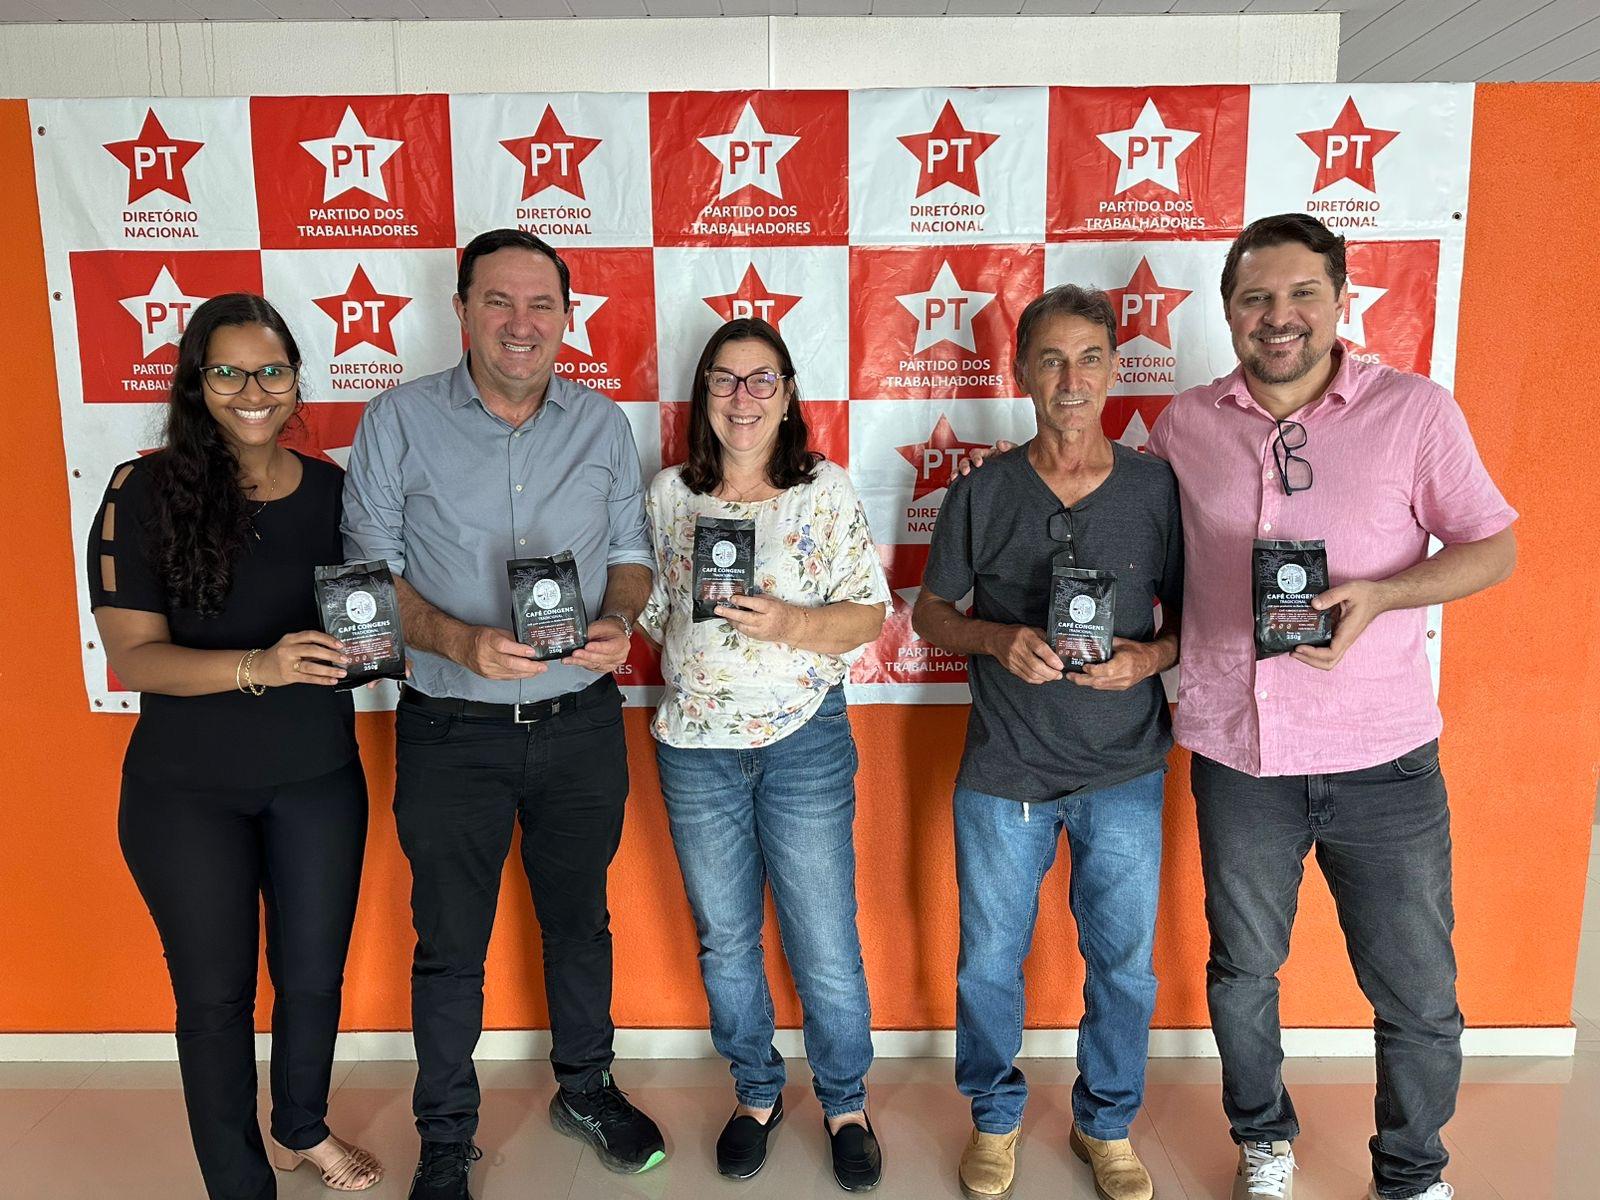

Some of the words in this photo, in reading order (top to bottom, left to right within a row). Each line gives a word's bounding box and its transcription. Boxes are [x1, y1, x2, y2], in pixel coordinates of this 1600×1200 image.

[728, 140, 773, 175] PT
[926, 138, 972, 174] PT
[1127, 135, 1173, 170] PT
[1325, 134, 1371, 169] PT
[133, 146, 178, 180] PT
[330, 143, 376, 178] PT
[530, 142, 575, 177] PT
[703, 205, 763, 218] PARTIDO
[768, 205, 797, 217] DOS
[910, 202, 985, 217] DIRETÓRIO
[1099, 200, 1160, 213] PARTIDO
[1164, 200, 1193, 212] DOS
[1306, 197, 1381, 212] DIRETÓRIO
[122, 208, 198, 223] DIRETÓRIO
[309, 208, 370, 221] PARTIDO
[374, 208, 404, 220] DOS
[516, 205, 592, 219] DIRETÓRIO
[518, 223, 592, 235] NACIONAL
[691, 221, 811, 235] TRABALHADORES
[910, 219, 984, 233] NACIONAL
[1085, 216, 1205, 230] TRABALHADORES
[1318, 216, 1378, 228] ACIONAL
[124, 226, 199, 238] NACIONAL
[297, 224, 418, 237] TRABALHADORES
[341, 300, 385, 333] PT
[732, 299, 775, 323] PT
[925, 297, 969, 331] PT
[1121, 293, 1165, 327] PT
[145, 302, 191, 335] PT
[329, 360, 404, 375] DIRETÓRIO
[579, 362, 608, 374] DOS
[899, 358, 958, 372] PARTIDO
[962, 358, 991, 370] DOS
[1119, 354, 1176, 368] RETÓRIO
[132, 363, 176, 375] PARTID
[886, 374, 1003, 388] TRABALHADORES
[1116, 371, 1175, 383] ACIONAL
[923, 448, 966, 480] PT
[525, 610, 543, 618] CAFÉ
[543, 606, 574, 616] CONGENS
[338, 624, 357, 634] CAFÉ
[357, 619, 391, 630] CONGENS
[1074, 623, 1105, 631] CONGENS
[897, 647, 953, 657] PARTIDO
[885, 661, 968, 672] TRABALHAD
